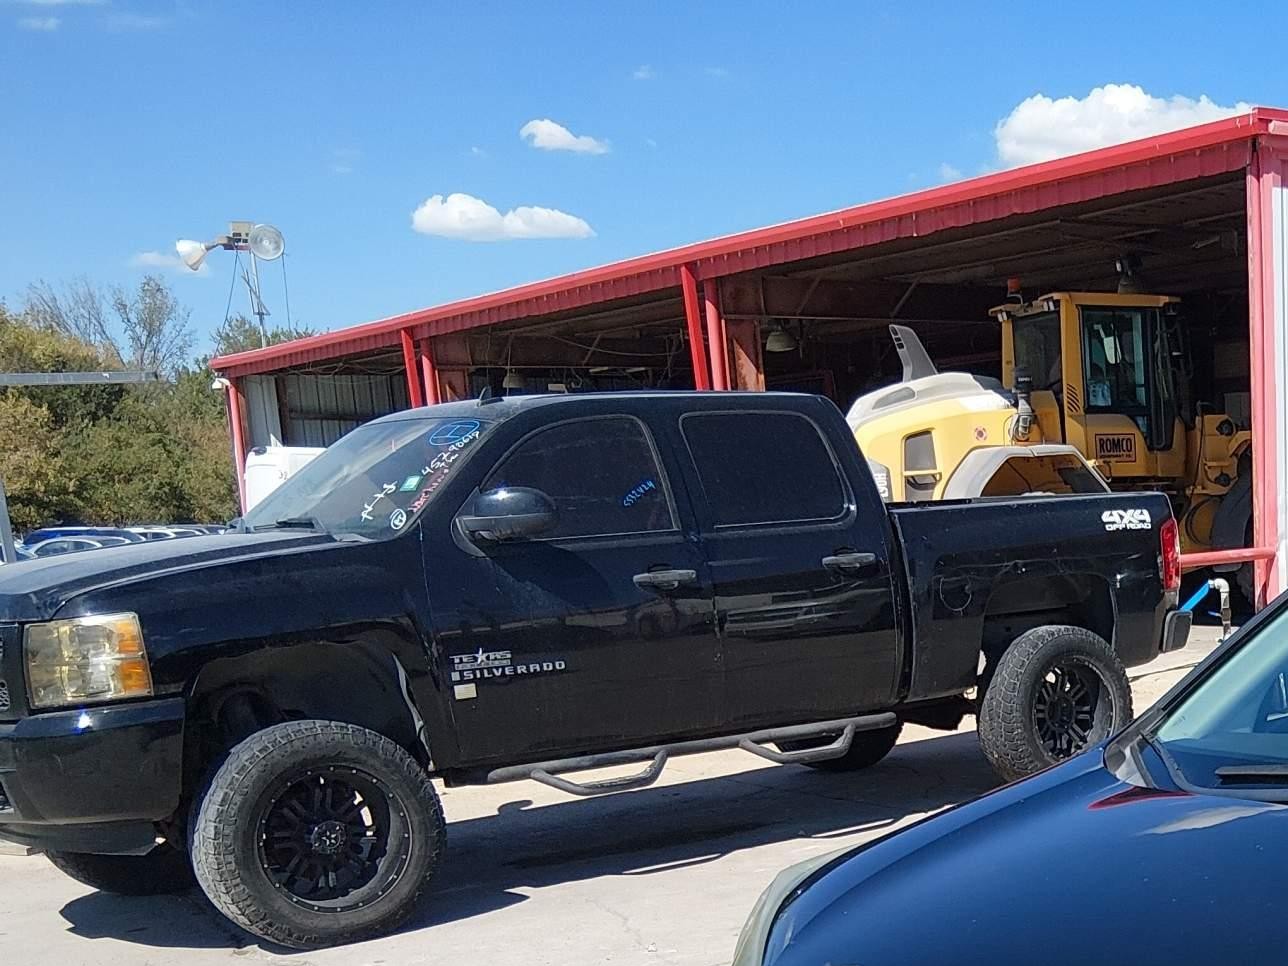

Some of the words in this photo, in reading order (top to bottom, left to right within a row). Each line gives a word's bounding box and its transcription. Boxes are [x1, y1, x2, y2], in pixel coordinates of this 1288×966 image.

[1099, 438, 1132, 453] ROMCO
[1105, 523, 1125, 531] OFF
[1127, 522, 1152, 530] ROAD
[449, 647, 512, 664] TEXAS
[463, 660, 566, 680] SILVERADO
